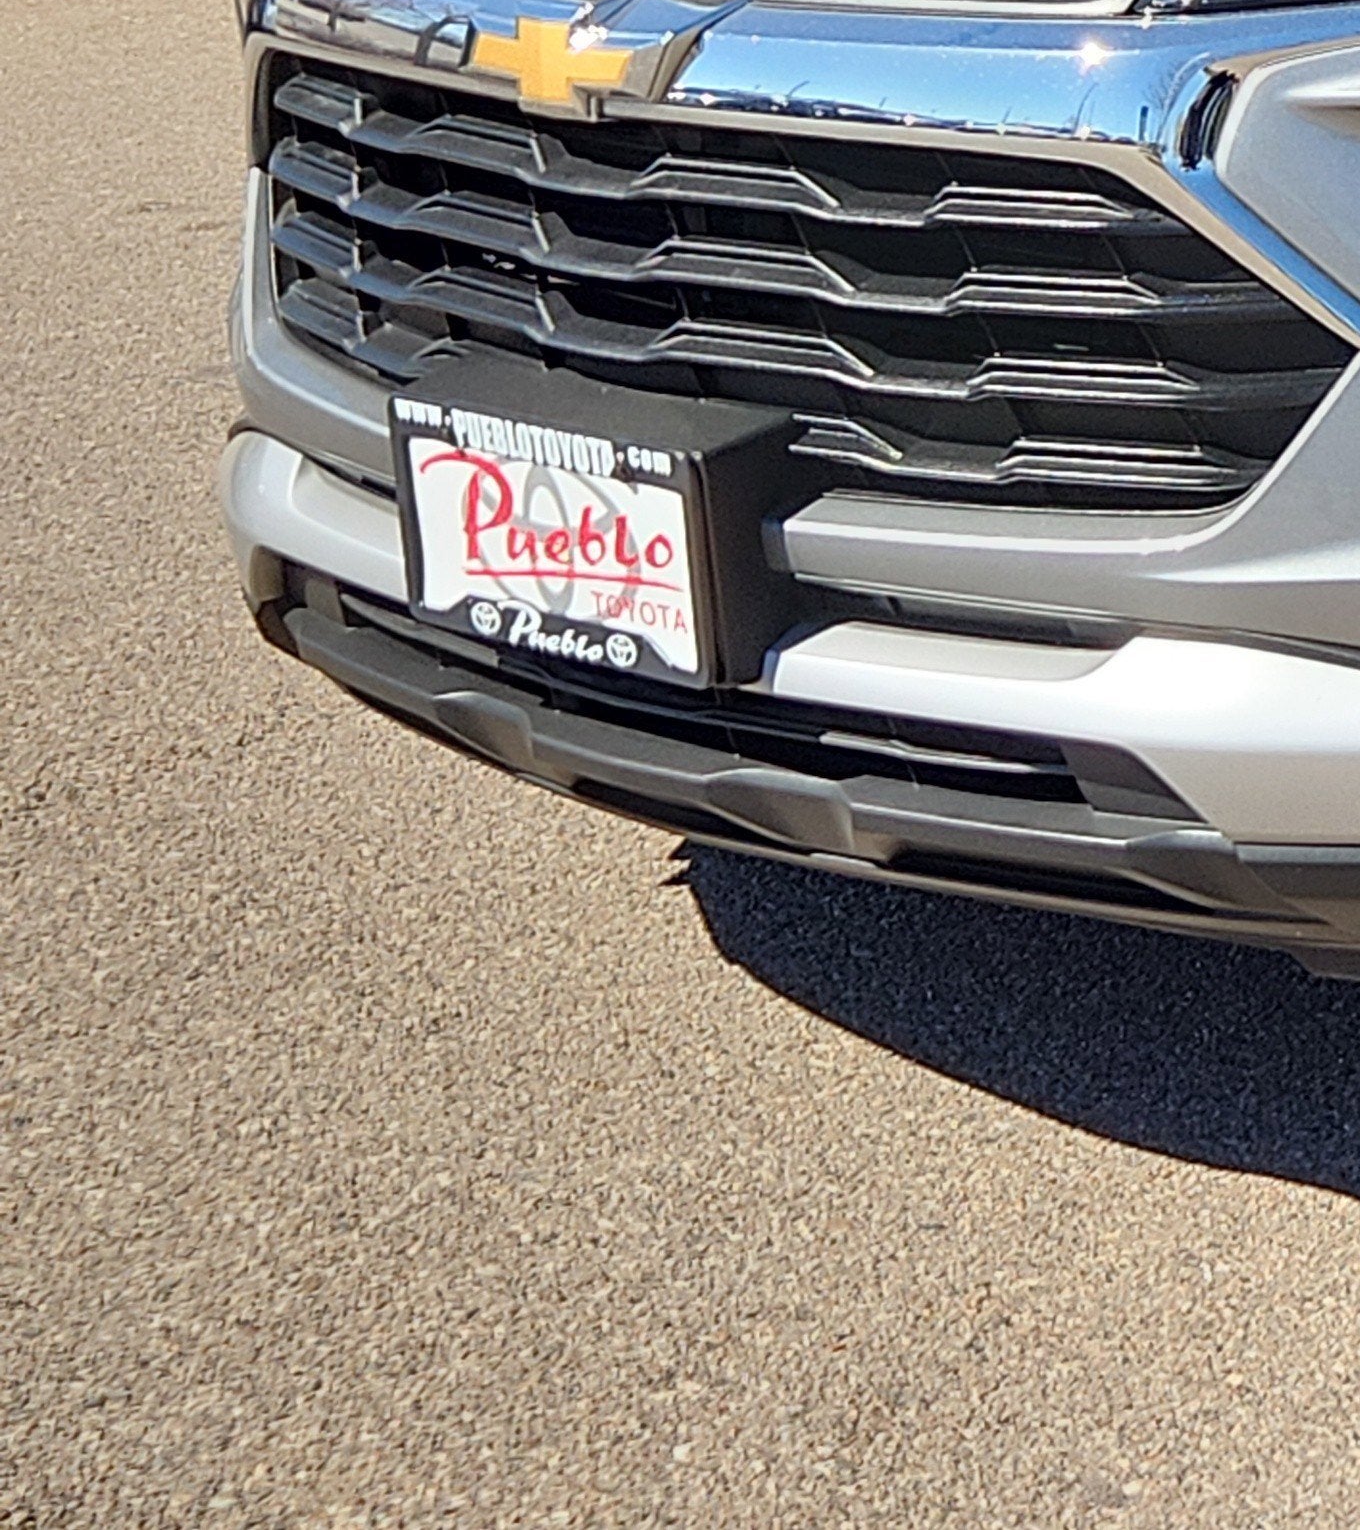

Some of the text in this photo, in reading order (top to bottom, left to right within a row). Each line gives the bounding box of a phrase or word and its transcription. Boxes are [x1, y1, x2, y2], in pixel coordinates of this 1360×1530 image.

[420, 449, 673, 569] Pueblo
[497, 599, 604, 664] Pueblo
[591, 590, 688, 634] TOYOTA
